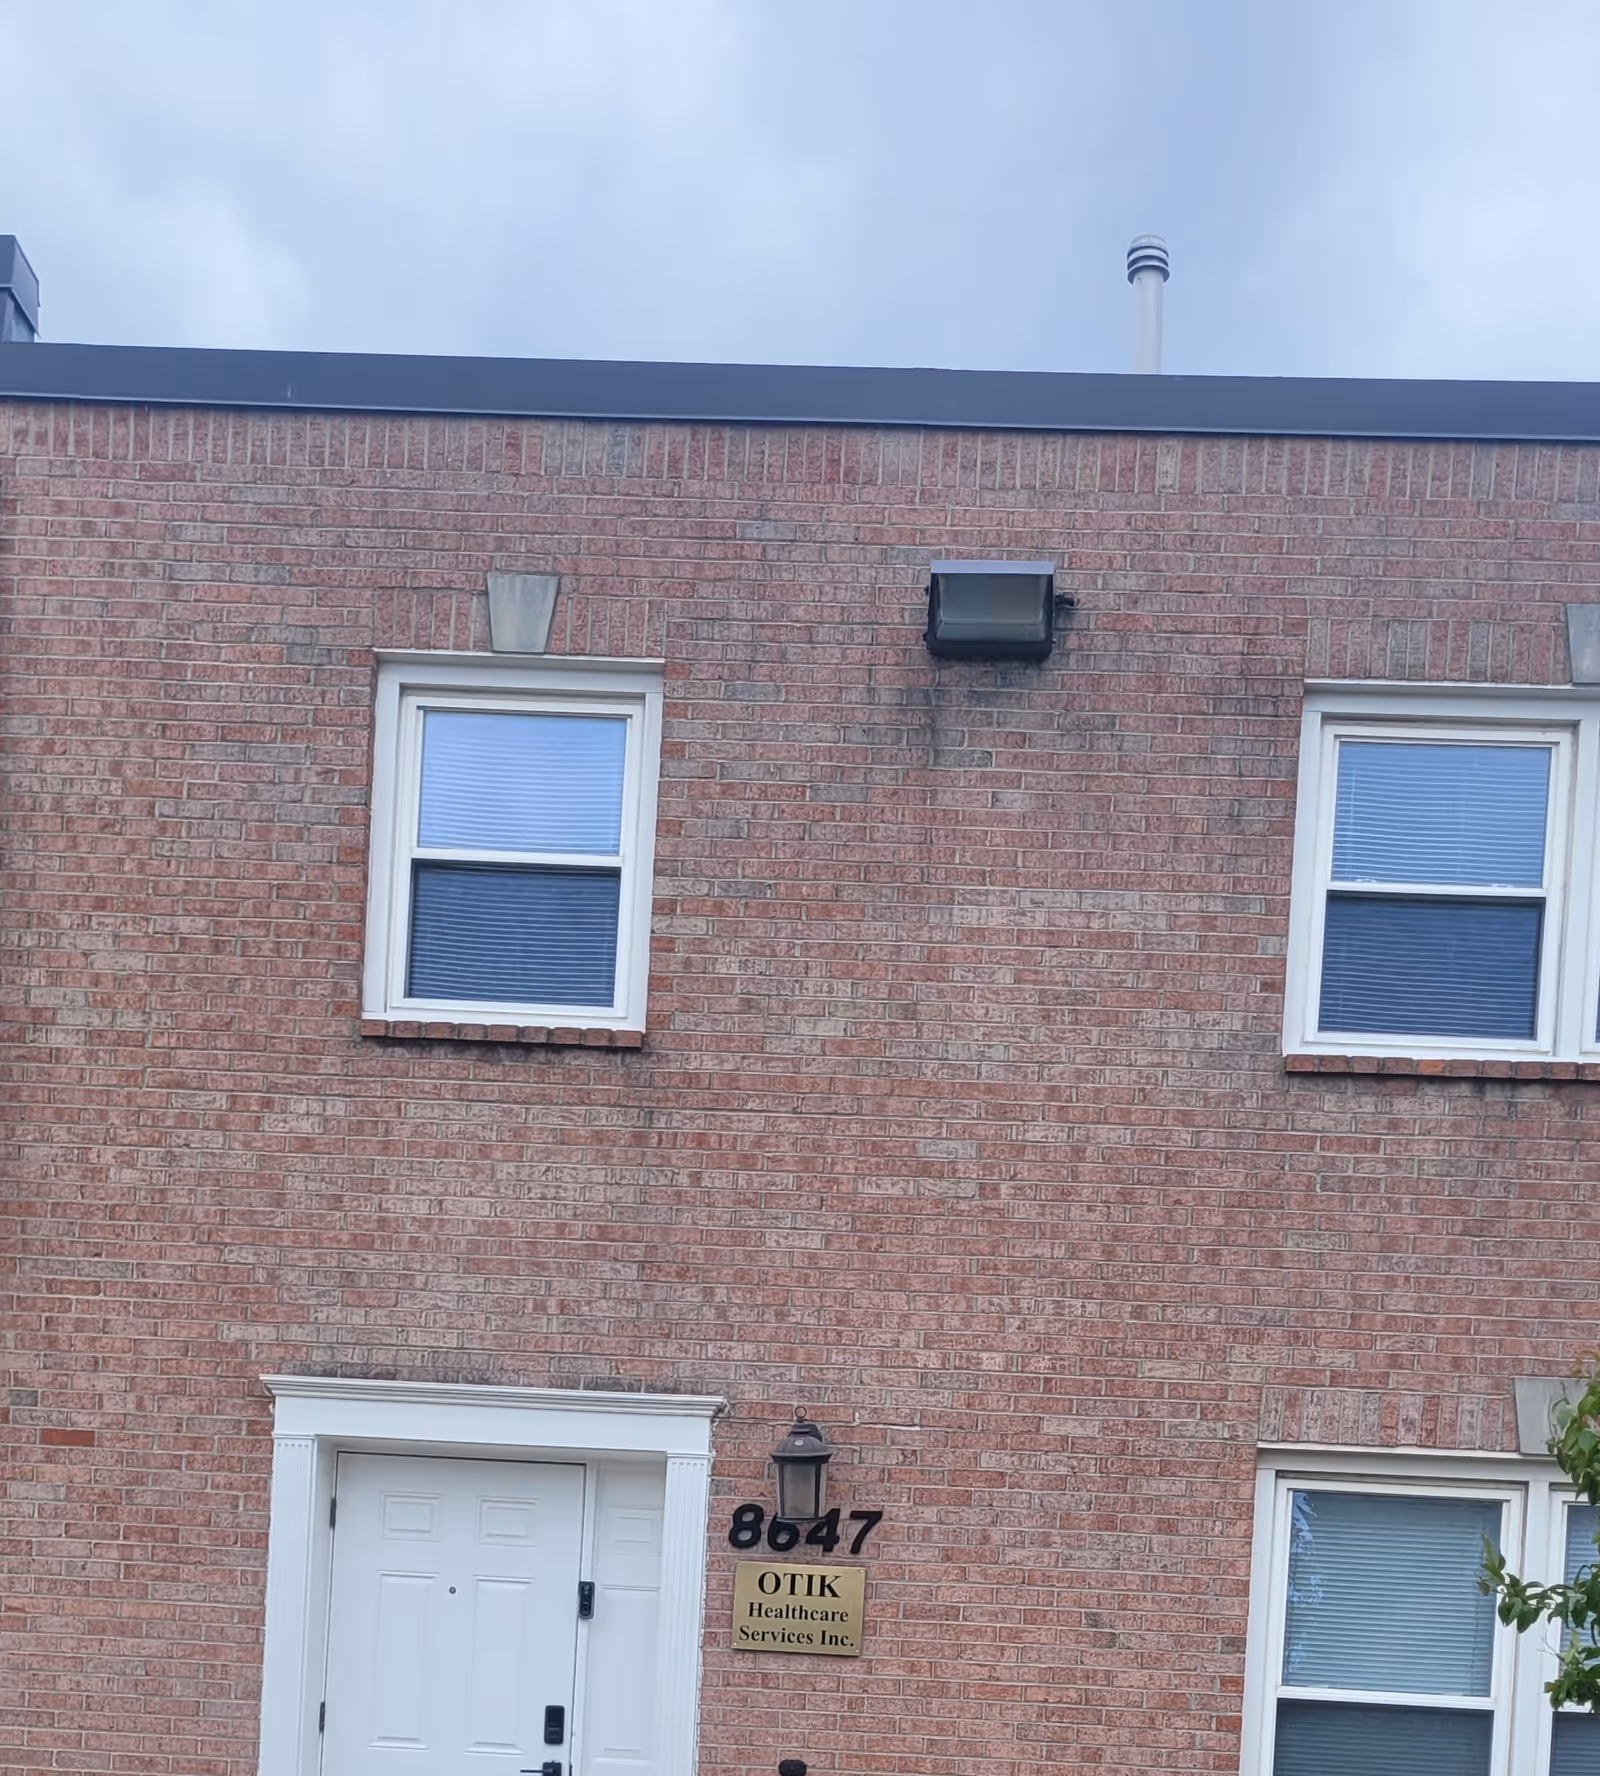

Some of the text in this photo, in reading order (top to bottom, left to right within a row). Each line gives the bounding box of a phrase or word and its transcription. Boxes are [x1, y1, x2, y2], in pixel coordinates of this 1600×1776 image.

[728, 1503, 883, 1554] 8647
[757, 1571, 842, 1598] OTIK
[748, 1601, 849, 1622] Healthcare
[738, 1624, 855, 1647] Services Inc.
